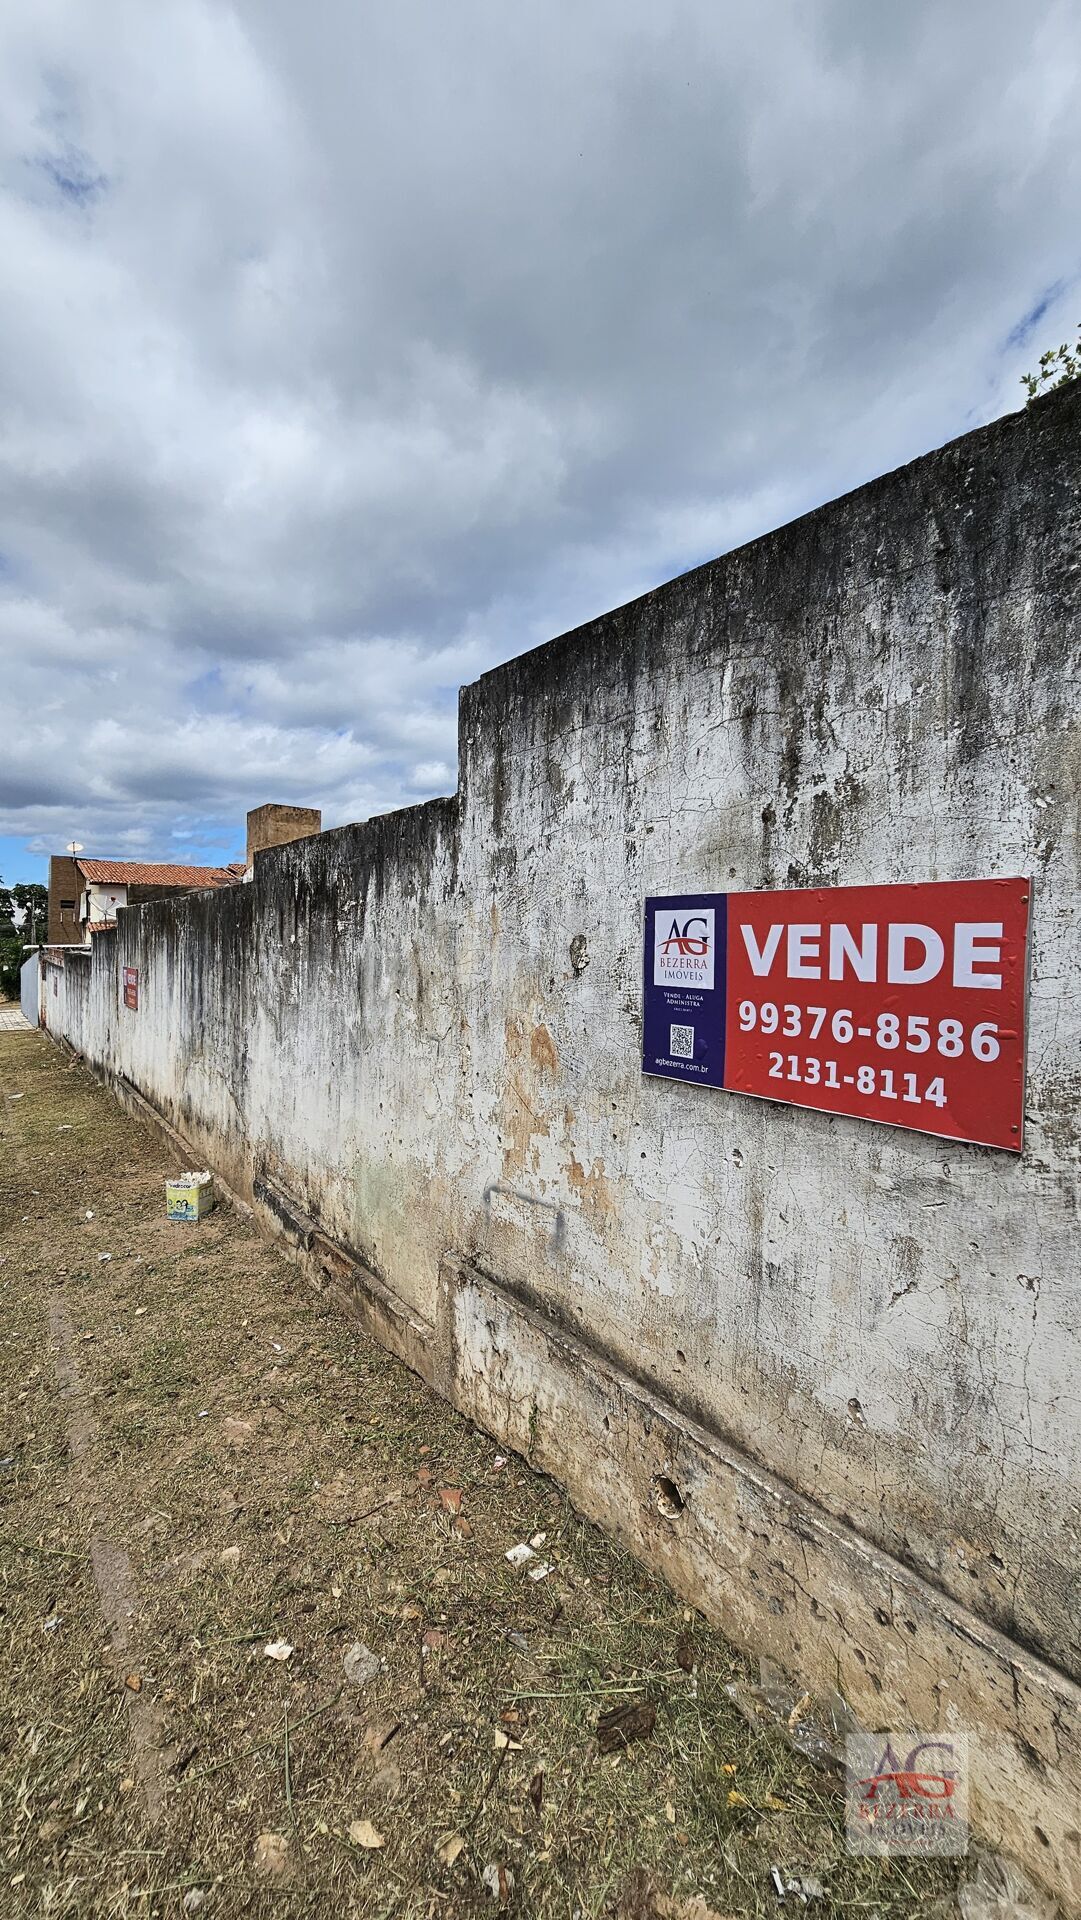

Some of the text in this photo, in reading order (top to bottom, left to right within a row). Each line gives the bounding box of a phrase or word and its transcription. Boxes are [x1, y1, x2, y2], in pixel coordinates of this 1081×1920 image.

[660, 917, 711, 956] AG
[660, 957, 708, 970] BEZERRA
[740, 922, 1003, 990] VENDE
[664, 968, 703, 981] IMÓVEIS
[666, 998, 701, 1007] ADMINISTRA
[738, 1000, 1000, 1063] 99376-8586
[655, 1057, 709, 1074] agbezerra.com.br
[768, 1052, 948, 1108] 2131-8114
